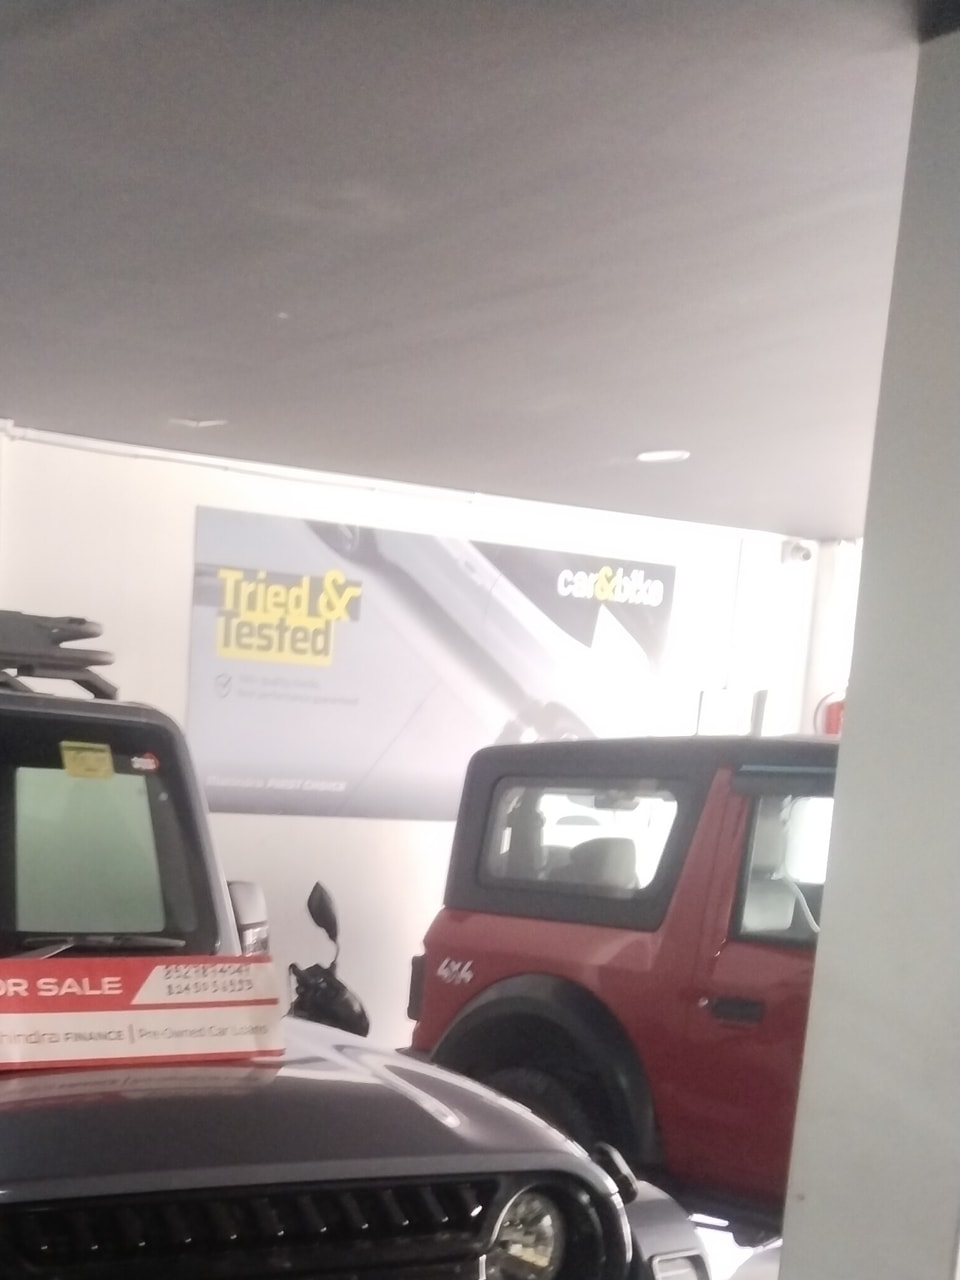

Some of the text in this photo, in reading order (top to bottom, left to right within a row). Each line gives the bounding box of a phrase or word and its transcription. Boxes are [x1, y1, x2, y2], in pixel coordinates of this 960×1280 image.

[218, 567, 361, 621] Tried &
[557, 565, 664, 607] car&bike
[217, 608, 331, 657] Tested
[37, 976, 123, 996] SALE
[63, 1030, 124, 1043] FINANCE
